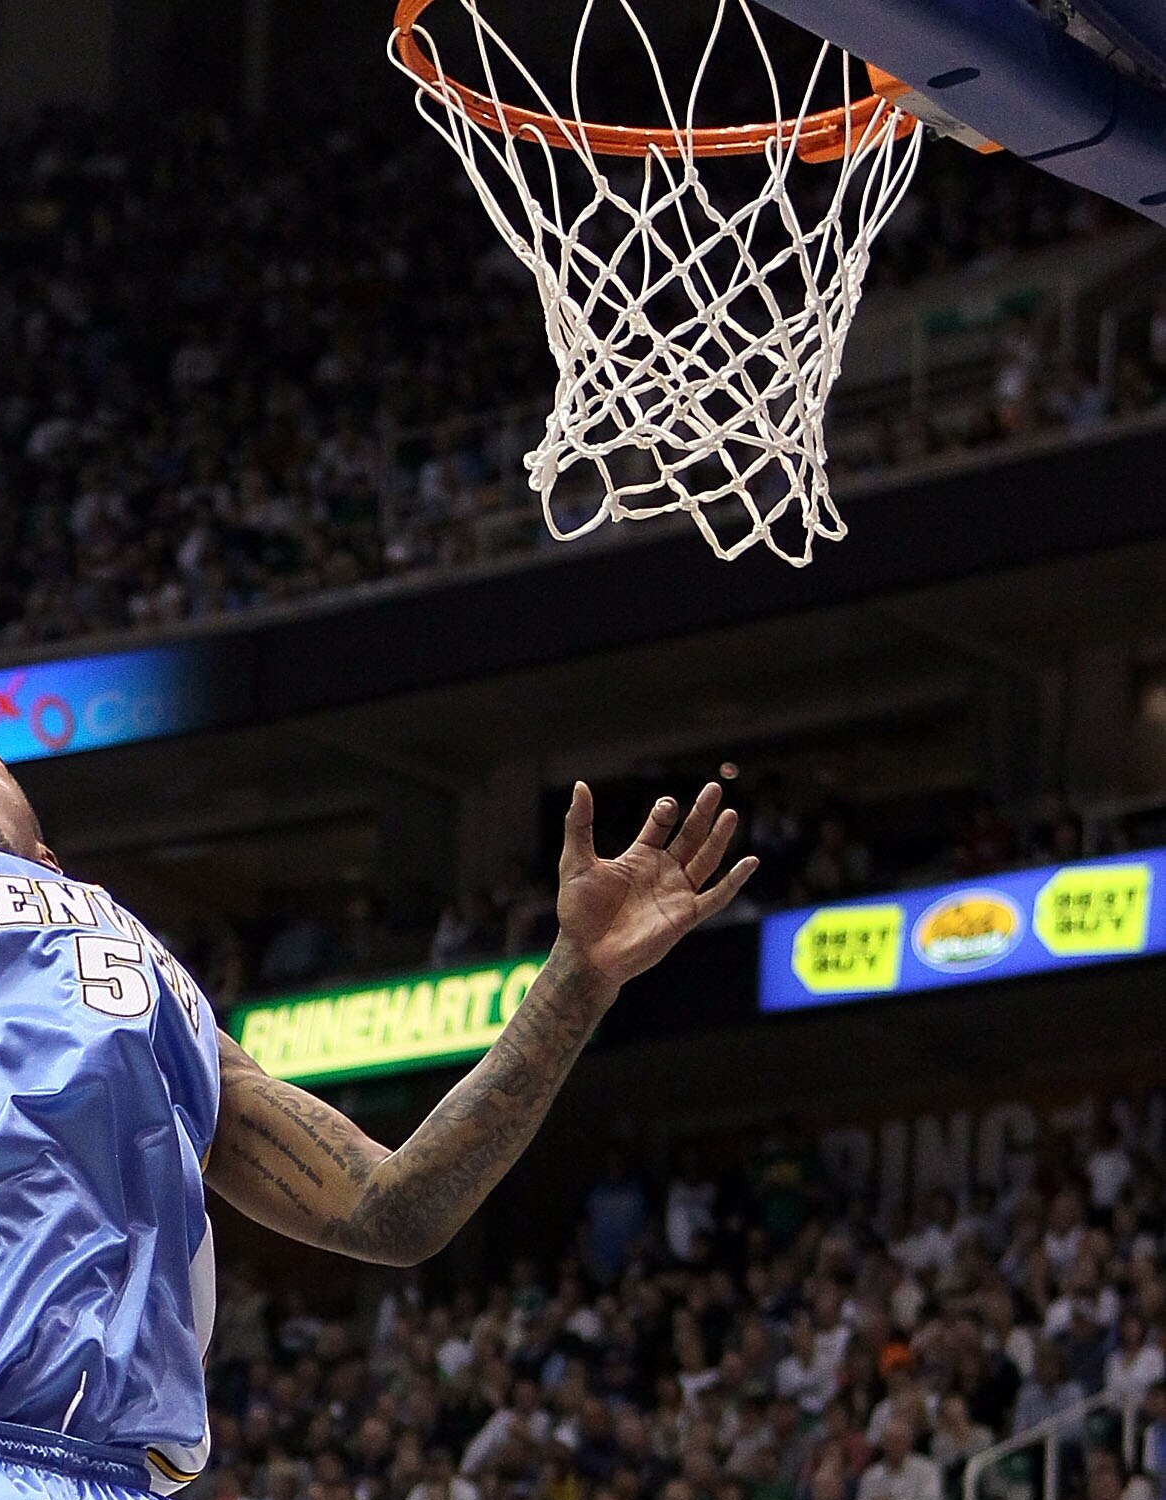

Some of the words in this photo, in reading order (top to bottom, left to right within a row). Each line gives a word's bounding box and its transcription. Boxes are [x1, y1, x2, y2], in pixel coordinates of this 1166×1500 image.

[1053, 887, 1138, 908] BEST
[1054, 916, 1123, 934] BUY
[812, 926, 890, 949] BEST
[813, 954, 878, 974] BUY
[74, 934, 153, 1020] 5
[240, 968, 504, 1064] RHINEHART
